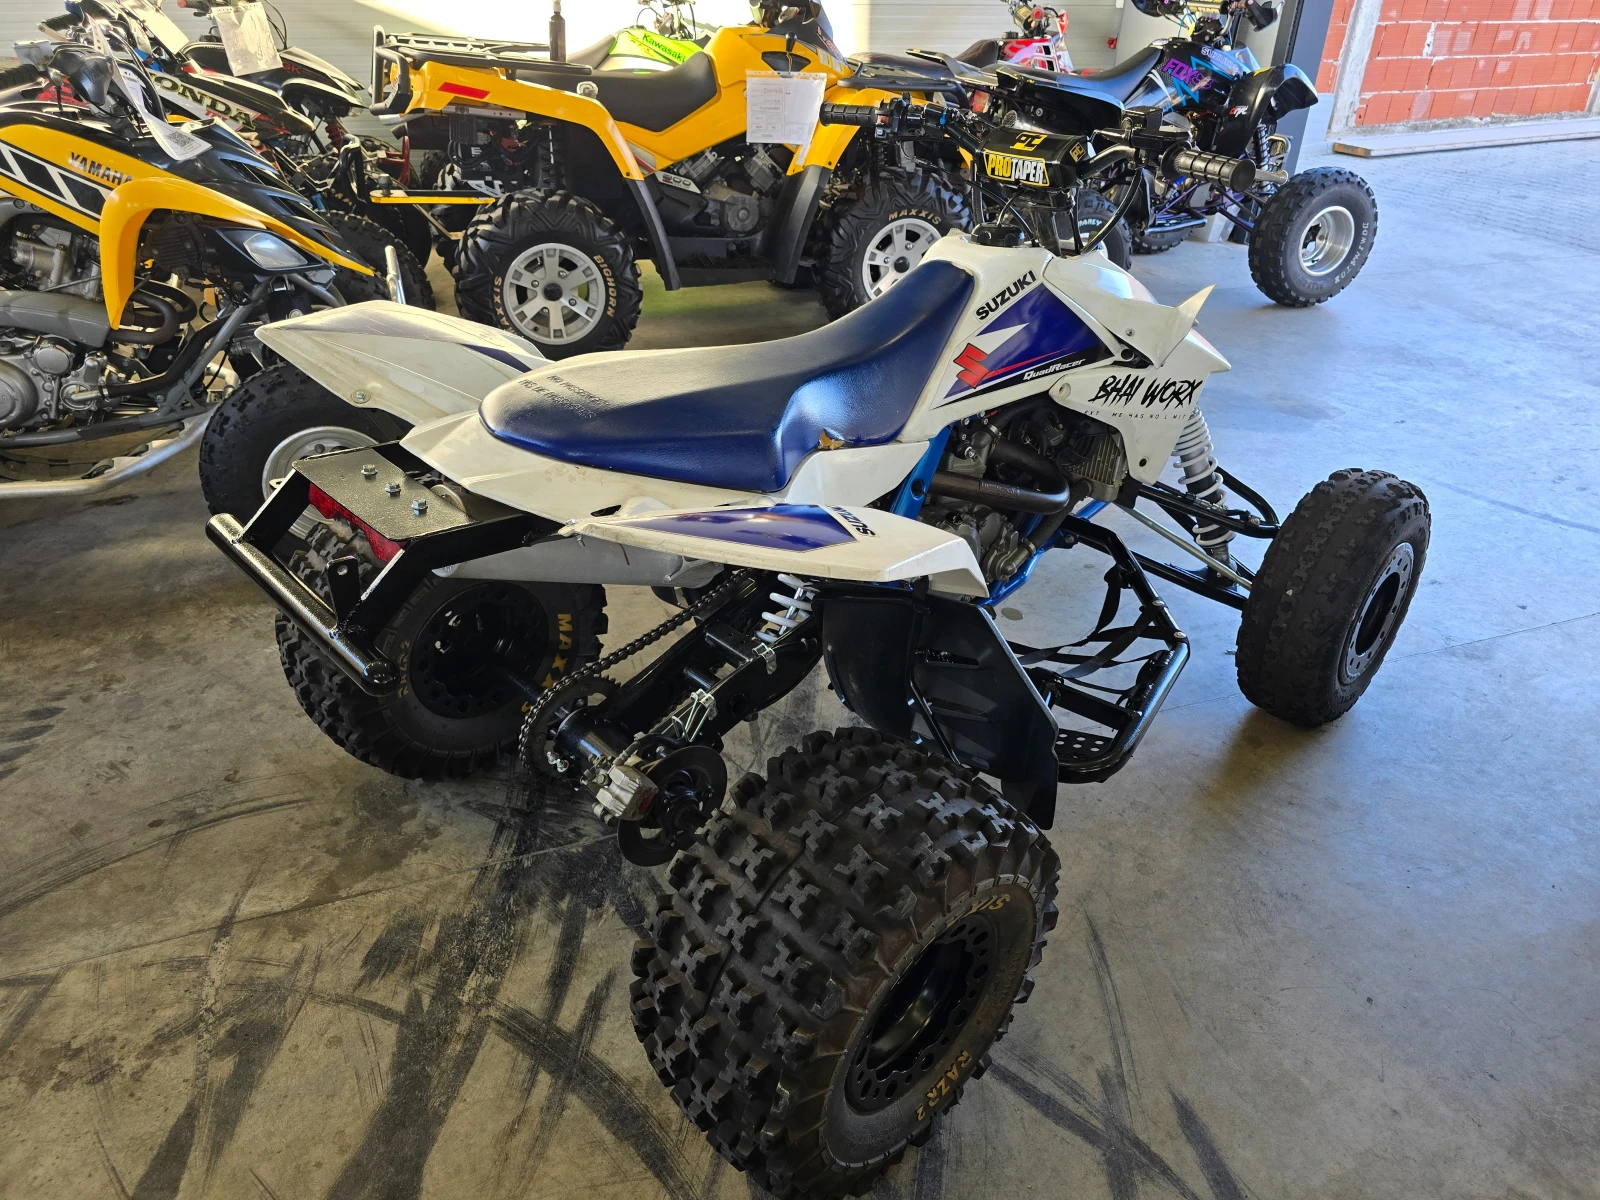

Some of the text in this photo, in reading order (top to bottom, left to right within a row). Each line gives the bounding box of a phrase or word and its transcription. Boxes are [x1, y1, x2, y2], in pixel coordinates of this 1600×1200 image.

[642, 33, 687, 63] Kawasaki
[1163, 58, 1199, 83] FOX
[149, 72, 256, 131] ONDA
[888, 208, 941, 225] MAXXIS
[593, 254, 617, 317] BIGHORN
[975, 270, 1037, 320] SUZUKI
[1022, 358, 1086, 381] QuadRacer
[1140, 377, 1203, 412] WORX
[521, 613, 573, 713] MAXXS
[916, 1050, 972, 1121] RAZR 2
